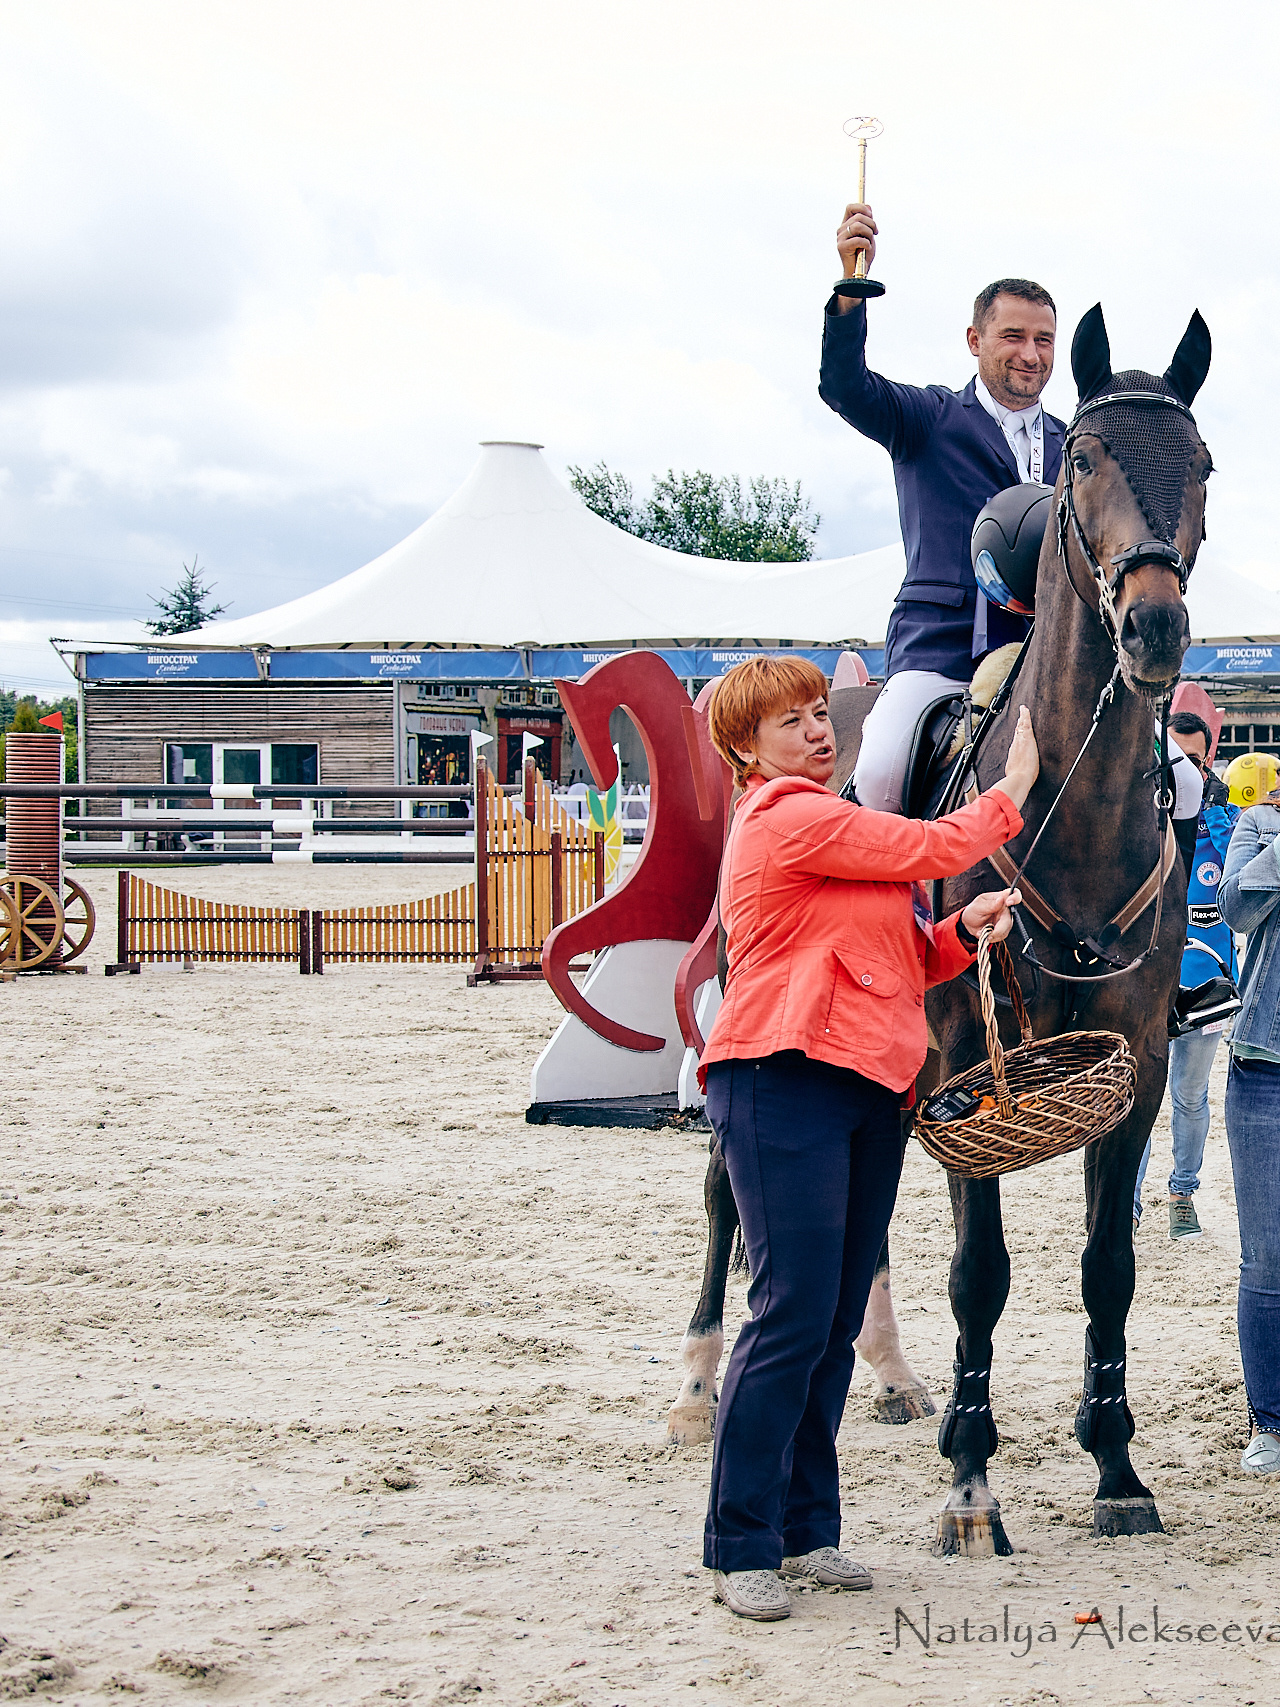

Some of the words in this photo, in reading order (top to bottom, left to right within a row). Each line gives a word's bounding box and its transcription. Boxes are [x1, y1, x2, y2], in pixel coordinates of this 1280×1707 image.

[1217, 648, 1273, 658] ИНГОССТРАХ
[147, 655, 198, 664] ИНГОССТРАХ
[370, 655, 421, 664] ИНГОССТРАХ
